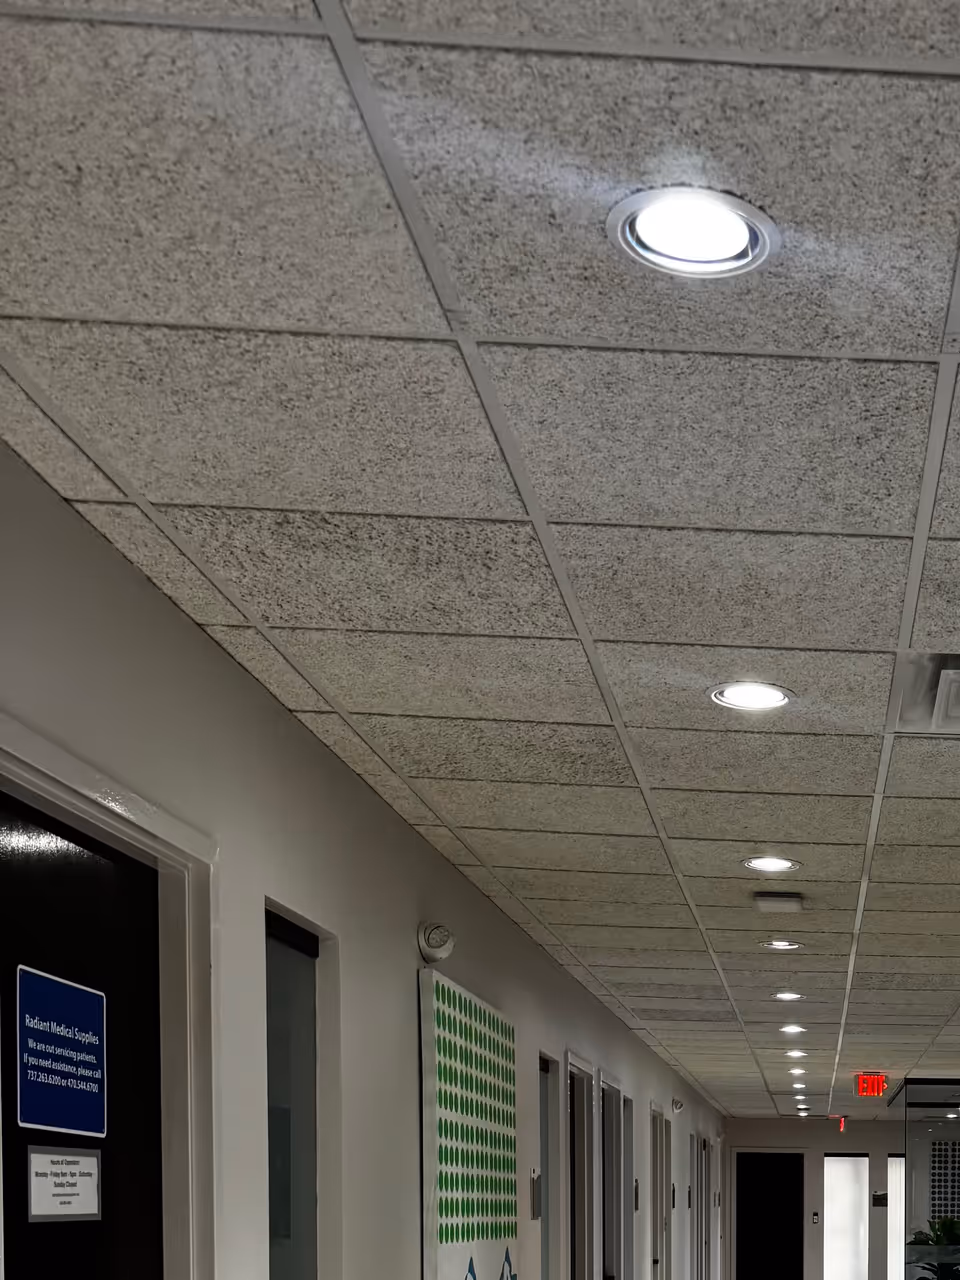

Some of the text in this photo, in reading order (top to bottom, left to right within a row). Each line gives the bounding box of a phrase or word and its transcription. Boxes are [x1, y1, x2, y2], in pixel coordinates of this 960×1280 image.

[25, 1014, 99, 1045] Radiant Medical Supplies
[28, 1038, 97, 1064] We are out servicing patients.
[23, 1052, 102, 1079] If you need assistance, please call
[62, 1079, 67, 1087] or
[858, 1075, 885, 1096] EXIT
